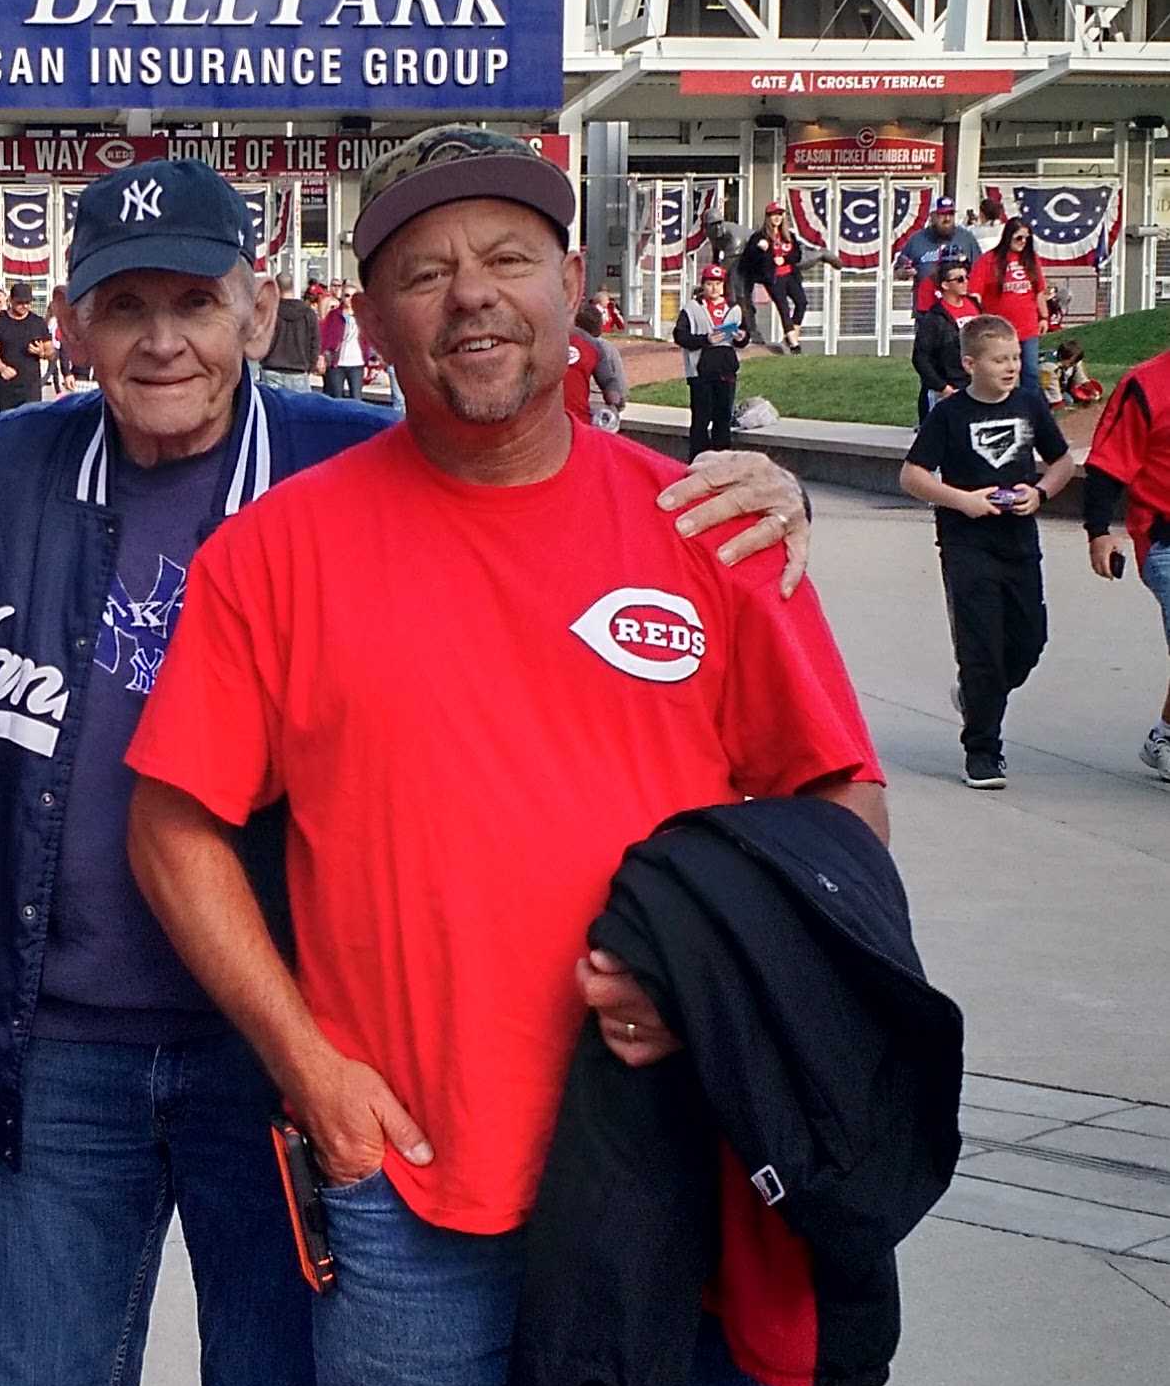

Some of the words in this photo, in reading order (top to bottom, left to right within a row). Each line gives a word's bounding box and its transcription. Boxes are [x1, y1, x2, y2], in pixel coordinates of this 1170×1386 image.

[90, 47, 342, 85] INSURANCE
[365, 47, 509, 86] GROUP
[751, 75, 787, 89] GATE
[787, 72, 805, 92] A
[817, 75, 880, 90] CROSLEY
[882, 75, 945, 89] TERRACE
[34, 139, 88, 171] WAY
[168, 139, 236, 170] HOME
[245, 139, 274, 170] OF
[283, 139, 328, 170] THE
[794, 149, 831, 164] SEASON
[834, 149, 867, 164] TICKET
[868, 149, 909, 164] MEMBER
[911, 148, 936, 163] GATE
[614, 617, 706, 657] REDS
